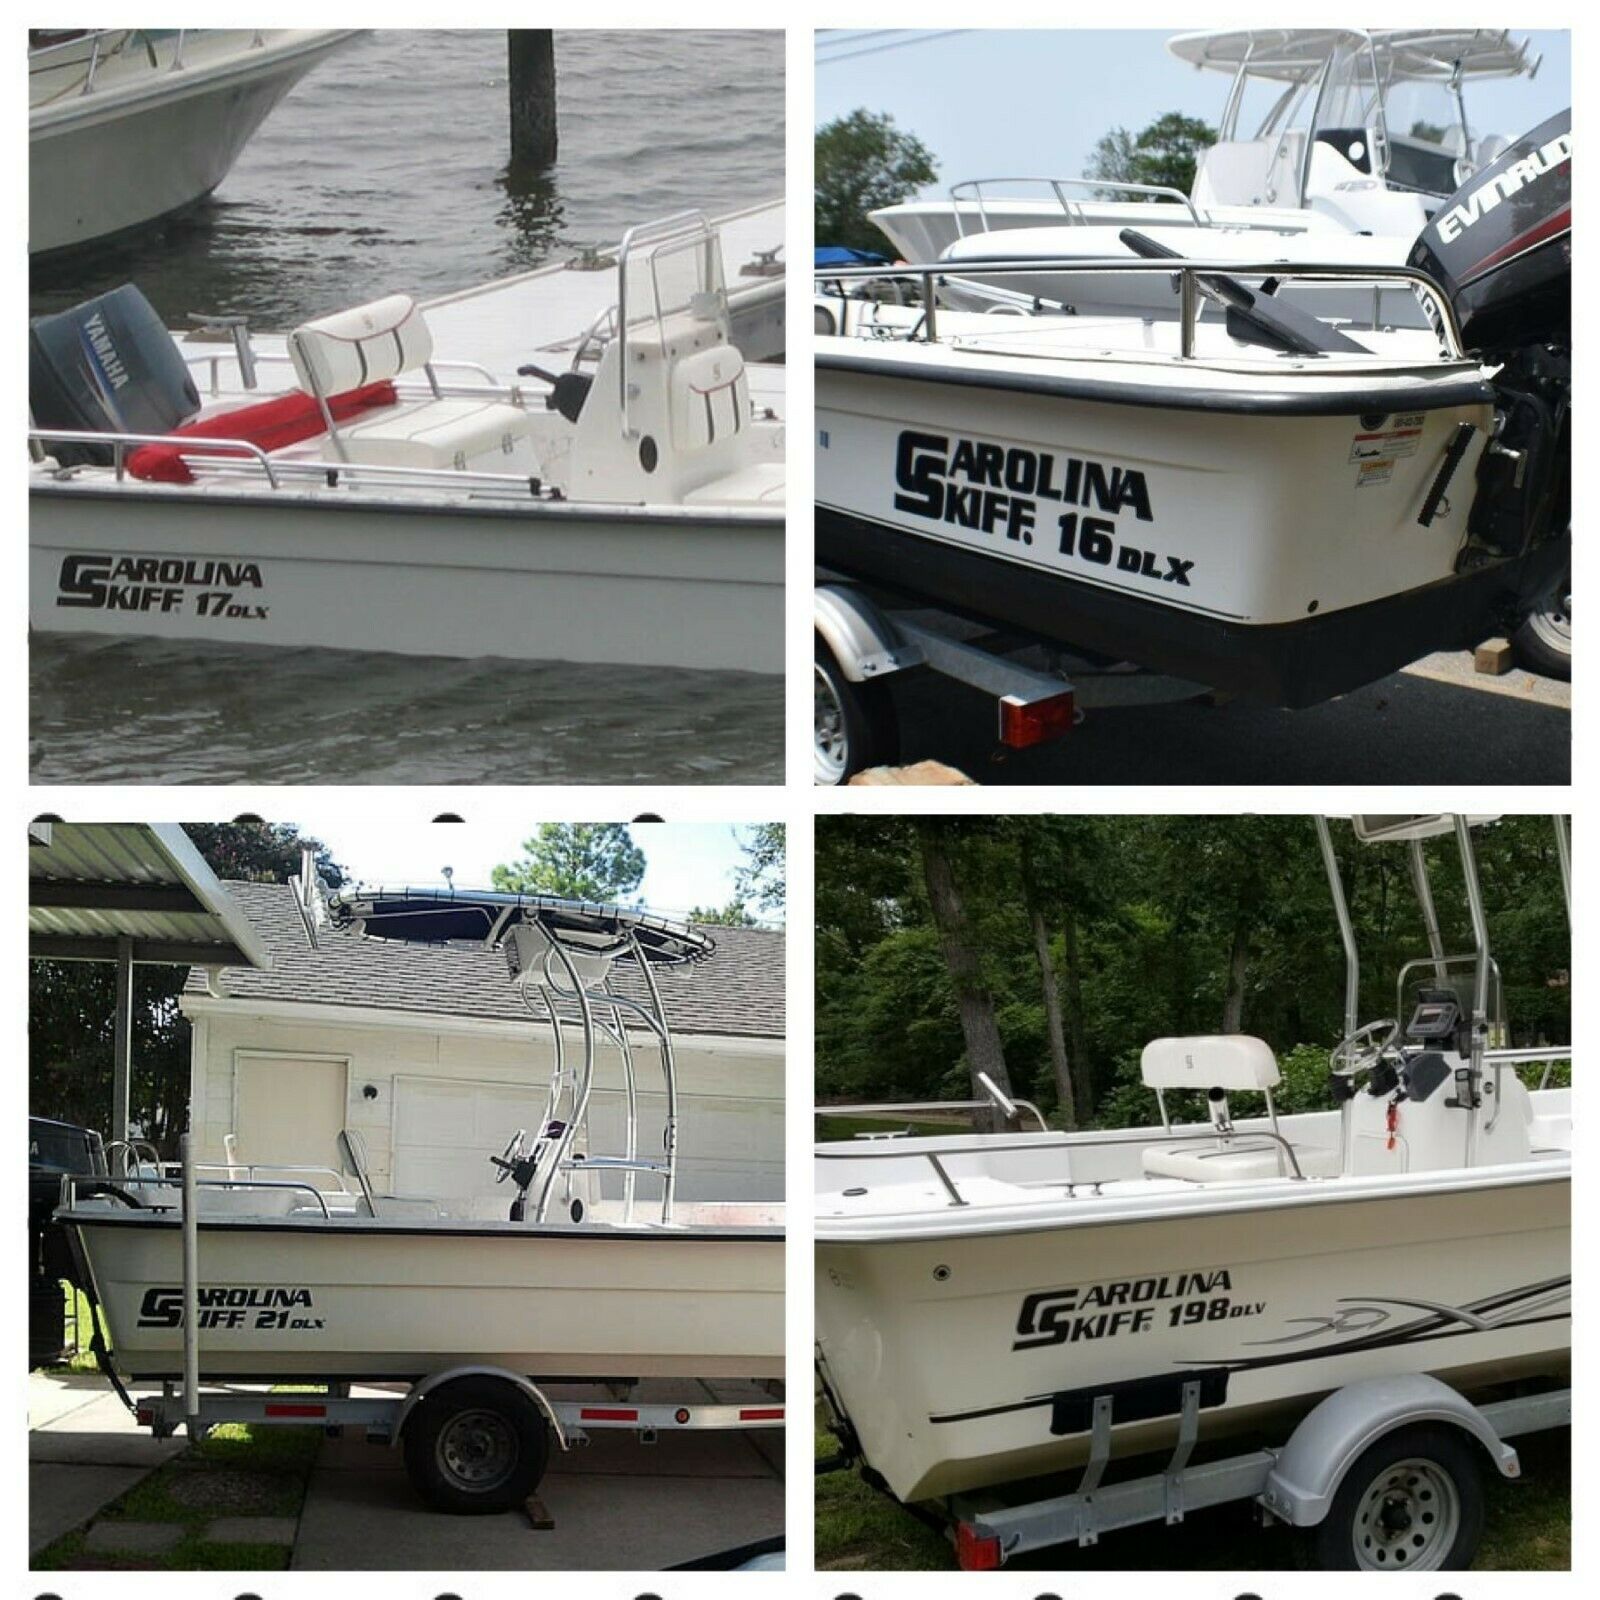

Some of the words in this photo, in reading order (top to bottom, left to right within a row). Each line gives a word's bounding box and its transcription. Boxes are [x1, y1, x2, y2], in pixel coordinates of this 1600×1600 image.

[83, 313, 129, 389] YAMAHA
[896, 430, 1153, 521] CAROLINA
[59, 555, 263, 590] CAROLINA
[137, 1299, 246, 1329] SIFF
[1017, 1270, 1232, 1335] CAROLINA
